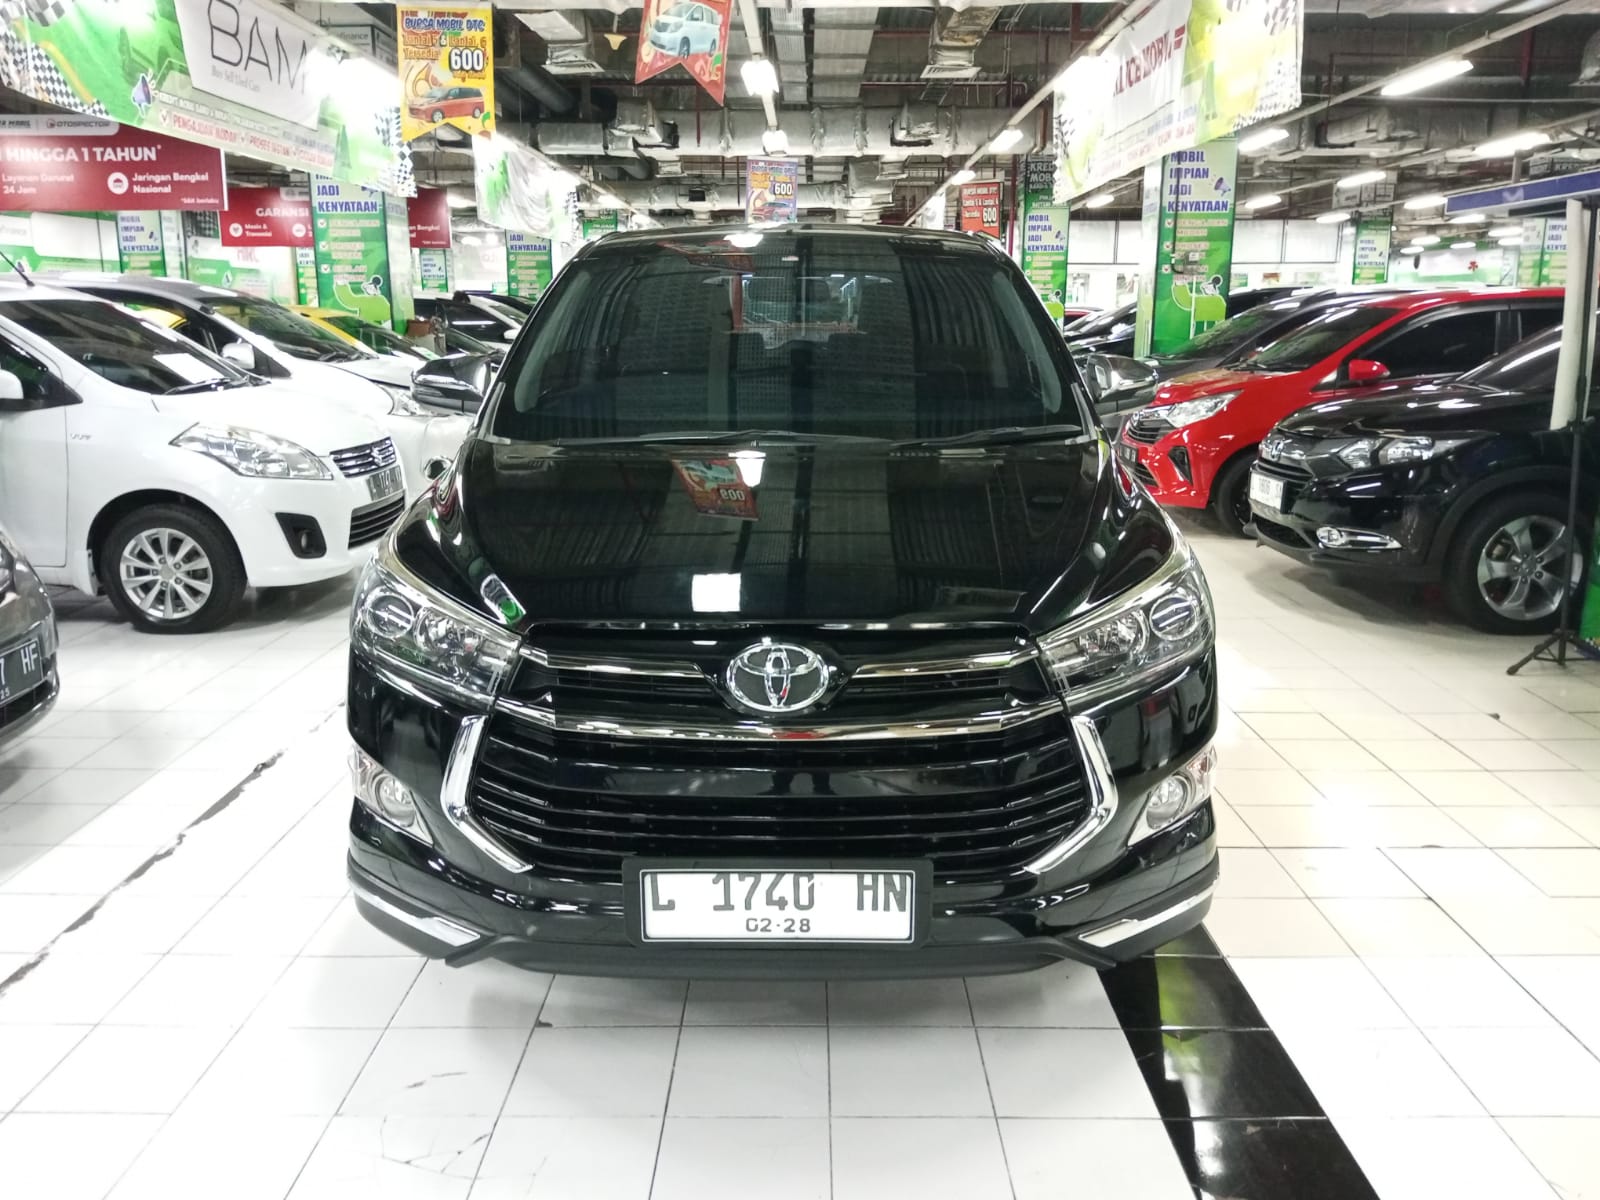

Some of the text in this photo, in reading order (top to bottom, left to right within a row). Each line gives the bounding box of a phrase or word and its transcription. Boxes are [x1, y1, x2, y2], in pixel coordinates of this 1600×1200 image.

[449, 48, 484, 72] 600
[6, 148, 79, 162] HINGGA
[82, 148, 90, 162] 1
[1170, 151, 1205, 163] MOBIL
[132, 172, 209, 183] Jaringan Bengkel
[3, 185, 37, 195] 24 Jam
[133, 184, 172, 194] Nasional
[316, 184, 340, 196] JADI
[774, 183, 793, 196] 600
[1168, 184, 1192, 196] JADI
[317, 201, 378, 213] KENYATAAN
[1167, 200, 1229, 212] KENYATAAN
[255, 207, 310, 218] GARANSI
[982, 207, 997, 223] 600
[1028, 214, 1049, 222] MOBIL
[1028, 224, 1052, 232] IMPIAN
[509, 233, 524, 242] JADI
[1028, 234, 1042, 242] JADI
[20, 642, 38, 675] HF
[650, 872, 907, 912] L 1740 HN
